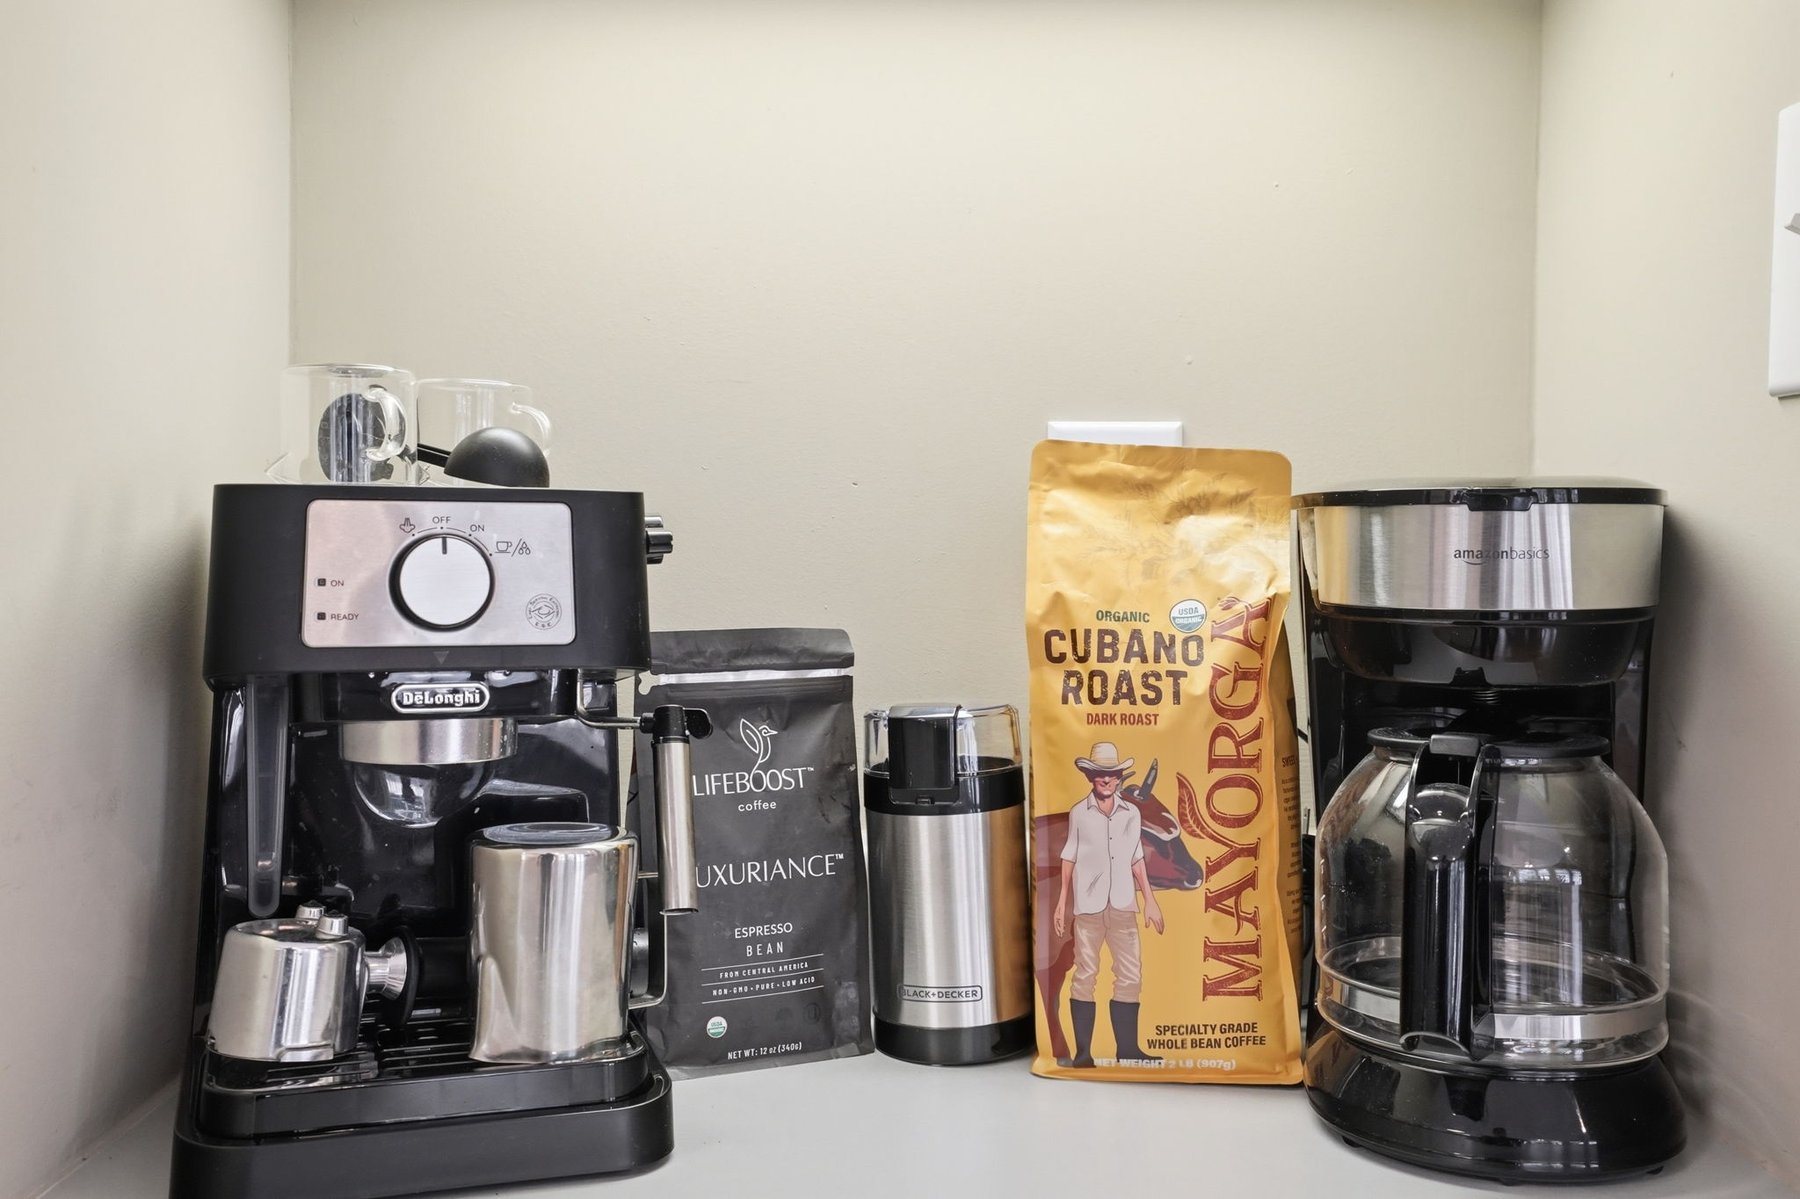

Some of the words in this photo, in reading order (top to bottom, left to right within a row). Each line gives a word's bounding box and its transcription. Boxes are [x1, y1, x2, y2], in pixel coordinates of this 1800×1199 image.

[432, 516, 451, 524] OFF
[469, 524, 485, 533] ON
[1453, 546, 1550, 560] amazonbasics
[330, 579, 345, 587] ON
[330, 613, 359, 621] READY
[1096, 609, 1150, 623] ORGANIC
[1178, 607, 1199, 616] USDA
[1044, 628, 1205, 667] CUBANO
[1061, 669, 1188, 706] ROAST
[1086, 713, 1117, 726] DARK
[1120, 713, 1160, 726] ROAST
[737, 800, 777, 812] coffee
[1201, 596, 1271, 1002] MAYORGA
[734, 922, 793, 939] ESPRESSO
[746, 941, 784, 957] BEAN
[719, 970, 740, 979] FROM
[742, 966, 776, 977] CENTRAL
[778, 961, 809, 972] AMERICA
[712, 985, 748, 996] NON-GMO
[755, 982, 775, 991] PURE
[781, 979, 797, 988] LOW
[799, 976, 816, 985] ACID
[1155, 1023, 1217, 1037] SPECIALTY
[1219, 1022, 1258, 1034] GRADE
[1147, 1037, 1188, 1050] WHOLE
[1190, 1037, 1222, 1049] BEAN
[1224, 1035, 1266, 1048] COFFEE
[727, 1050, 742, 1060] NET
[744, 1048, 758, 1058] WT:
[760, 1047, 768, 1056] 12
[1093, 1058, 1116, 1067] NET
[1119, 1058, 1166, 1068] WEIGHT
[1168, 1059, 1175, 1068] 2
[1179, 1059, 1194, 1068] LB
[1196, 1059, 1236, 1071] (907g)
